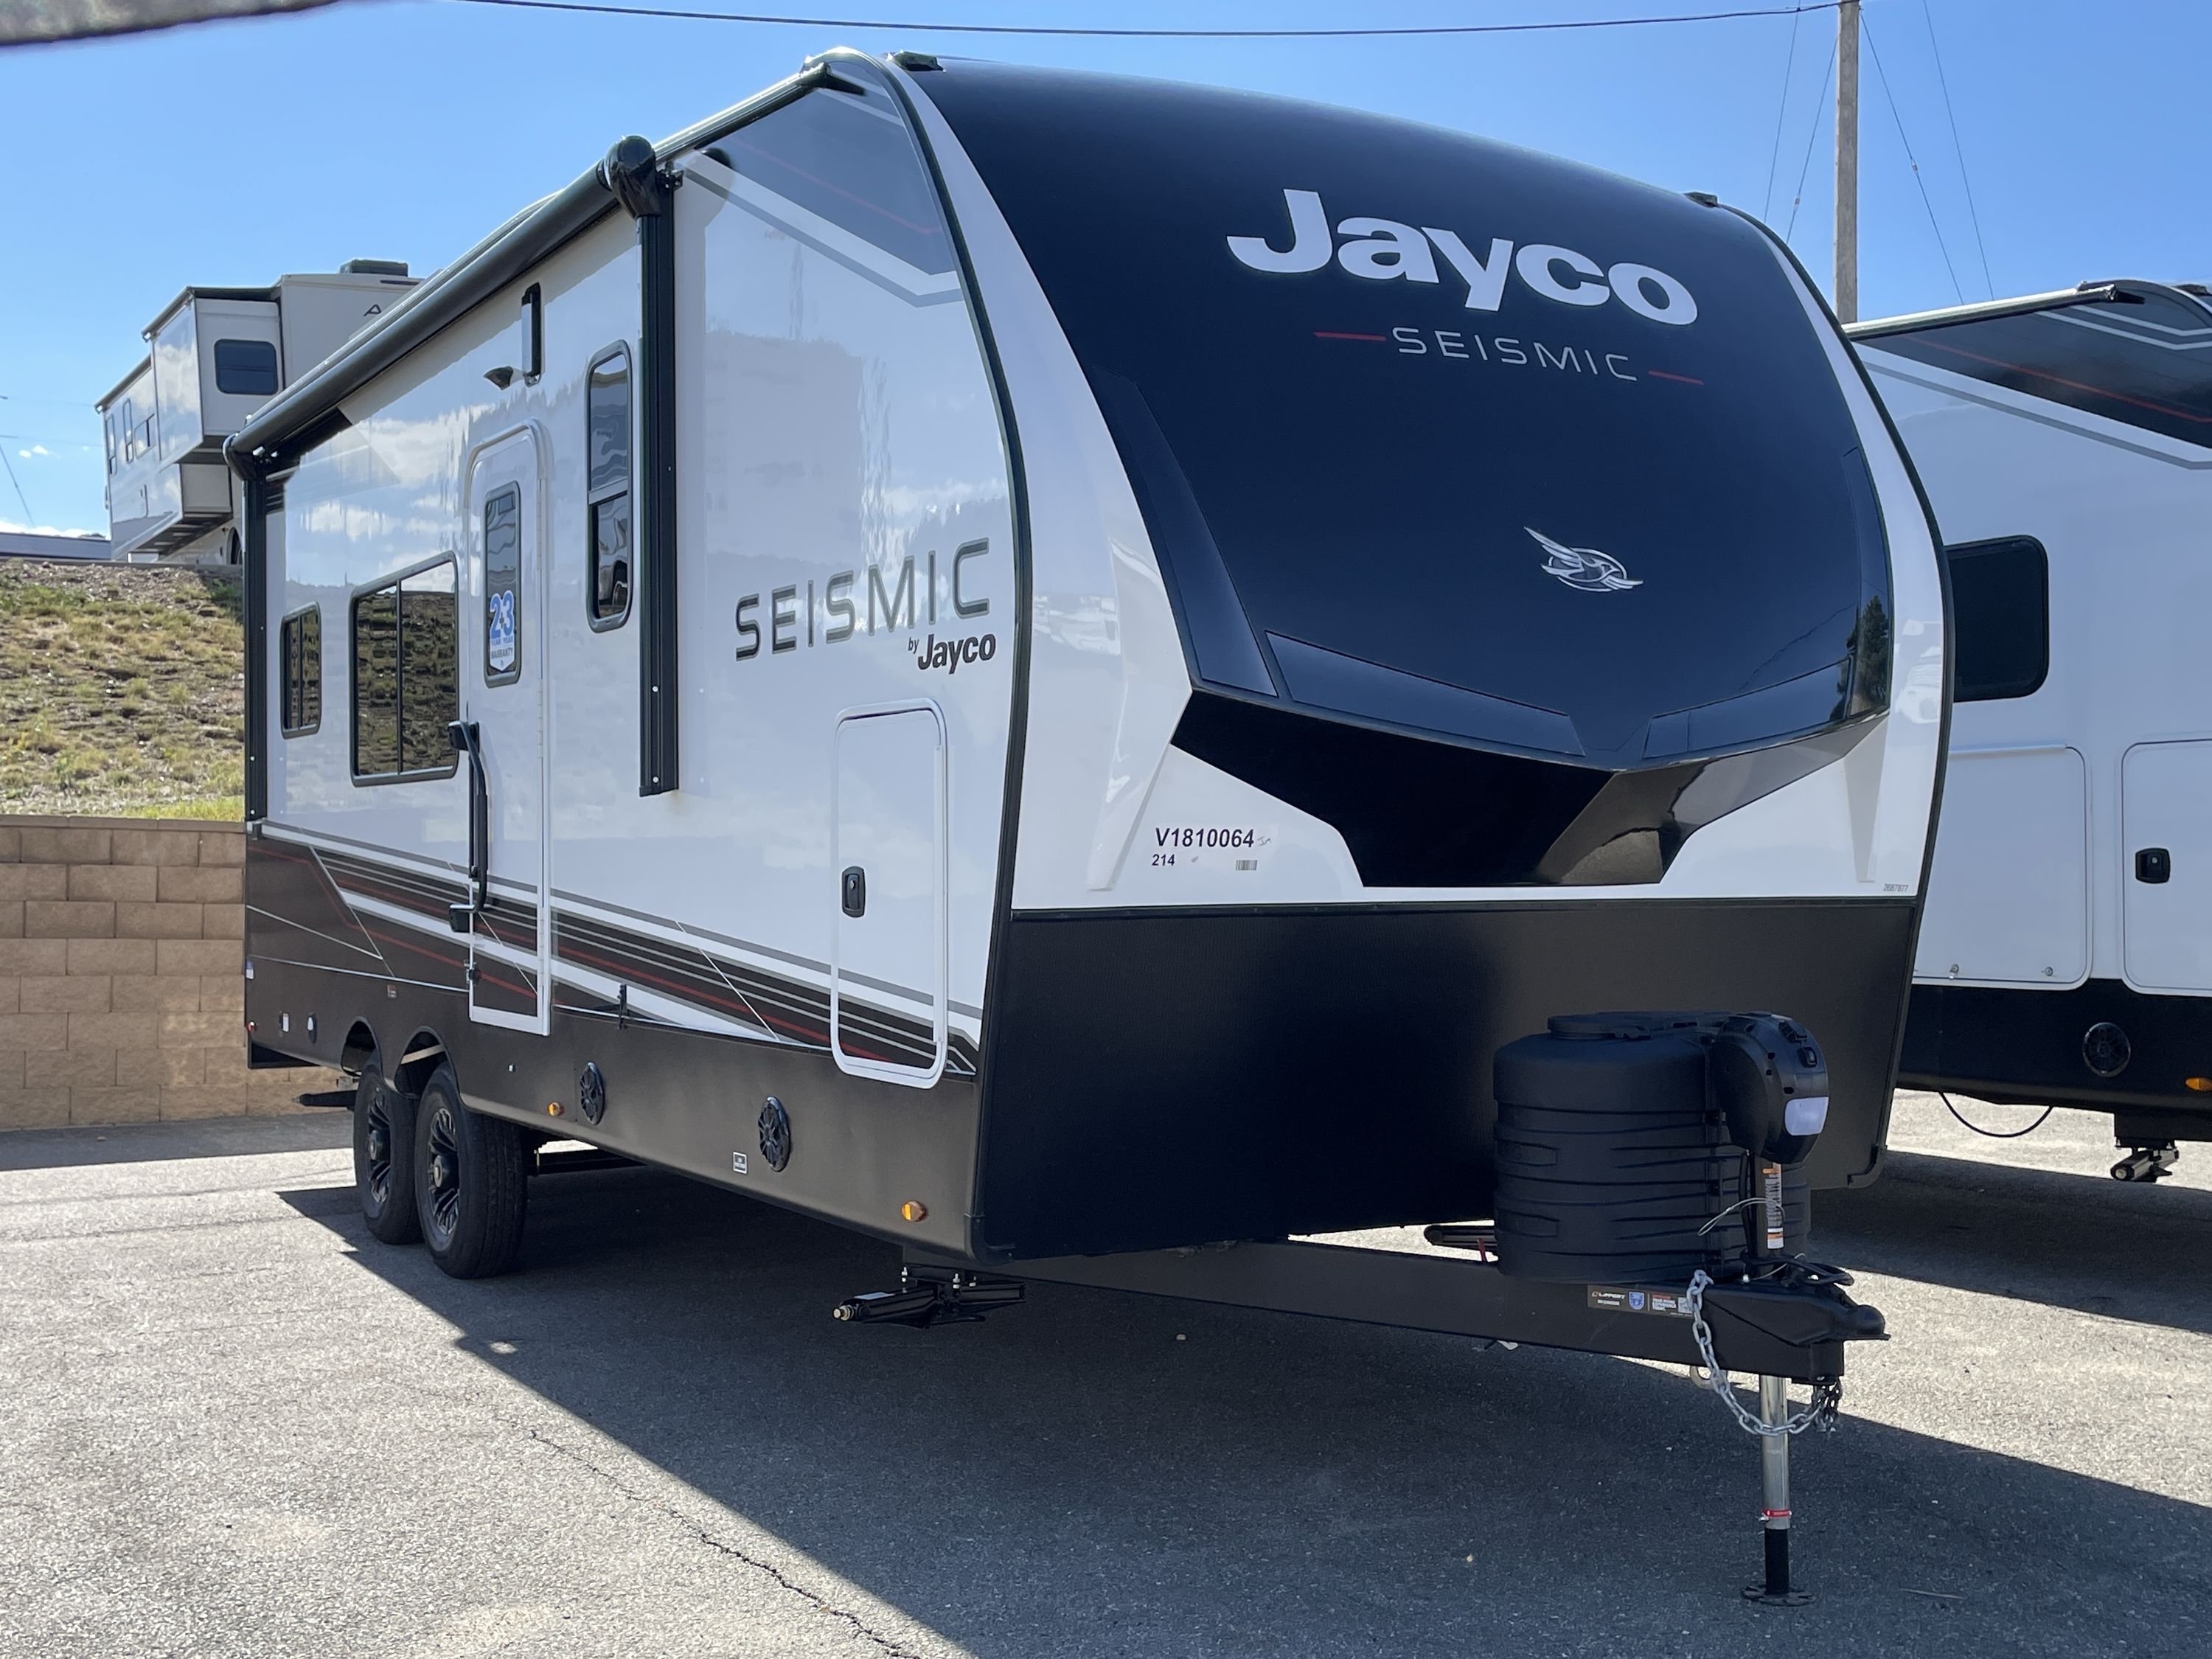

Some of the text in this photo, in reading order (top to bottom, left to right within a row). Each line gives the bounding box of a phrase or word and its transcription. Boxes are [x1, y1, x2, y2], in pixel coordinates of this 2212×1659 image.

[1226, 187, 1698, 326] Jayco
[1391, 327, 1638, 382] SEISMIC
[735, 537, 990, 662] SEISMIC
[908, 633, 997, 675] by Jayco
[1151, 853, 1175, 866] 214
[1155, 827, 1255, 848] V1810064
